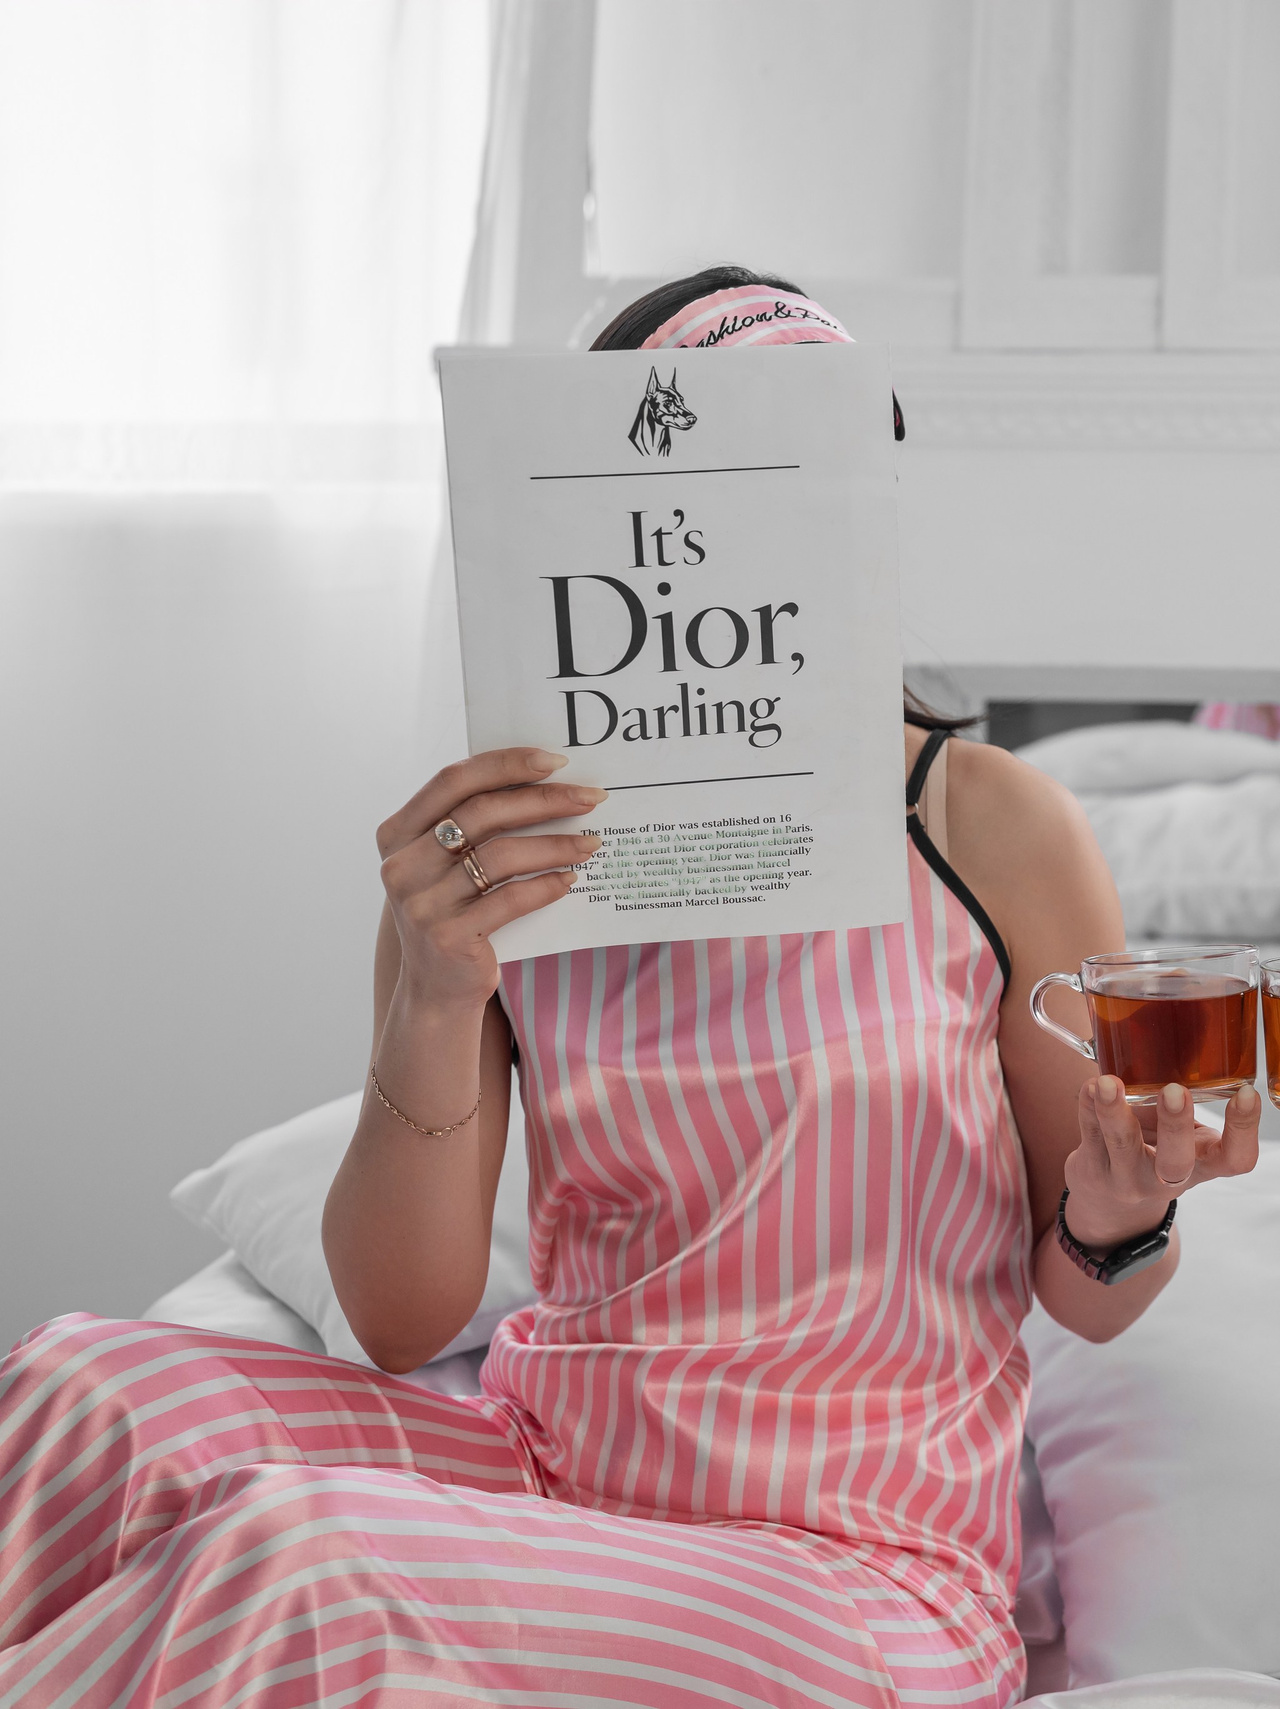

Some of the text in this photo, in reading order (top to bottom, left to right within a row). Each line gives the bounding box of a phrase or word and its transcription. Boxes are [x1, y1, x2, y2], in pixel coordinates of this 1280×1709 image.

[627, 508, 706, 568] It's
[538, 574, 805, 680] Dior,
[558, 682, 782, 748] Darling
[580, 813, 792, 837] The House of Dior was established on 16
[617, 836, 641, 846] 1946
[644, 836, 654, 844] at
[657, 834, 671, 843] 30
[673, 831, 713, 842] Avenue
[715, 827, 769, 839] Montaigne
[772, 826, 782, 834] in
[785, 823, 813, 834] Paris.
[613, 849, 630, 857] the
[633, 845, 671, 856] current
[674, 843, 696, 853] Dior
[699, 839, 759, 851] corporation
[762, 836, 814, 846] celebrates
[617, 859, 633, 868] the
[636, 857, 678, 867] opening
[681, 855, 707, 865] year.
[709, 852, 732, 862] Dior
[735, 852, 755, 860] was
[758, 846, 811, 858] financially
[586, 858, 791, 881] backed by wealthy businessman Marcel
[709, 876, 721, 884] as
[724, 874, 740, 882] the
[743, 871, 784, 883] opening
[787, 869, 813, 879] year.
[588, 893, 611, 903] Dior
[637, 888, 691, 899] financially
[695, 884, 731, 896] backed
[734, 884, 748, 893] by
[750, 881, 791, 892] wealthy
[615, 894, 766, 911] businessman Marcel Boussac.
